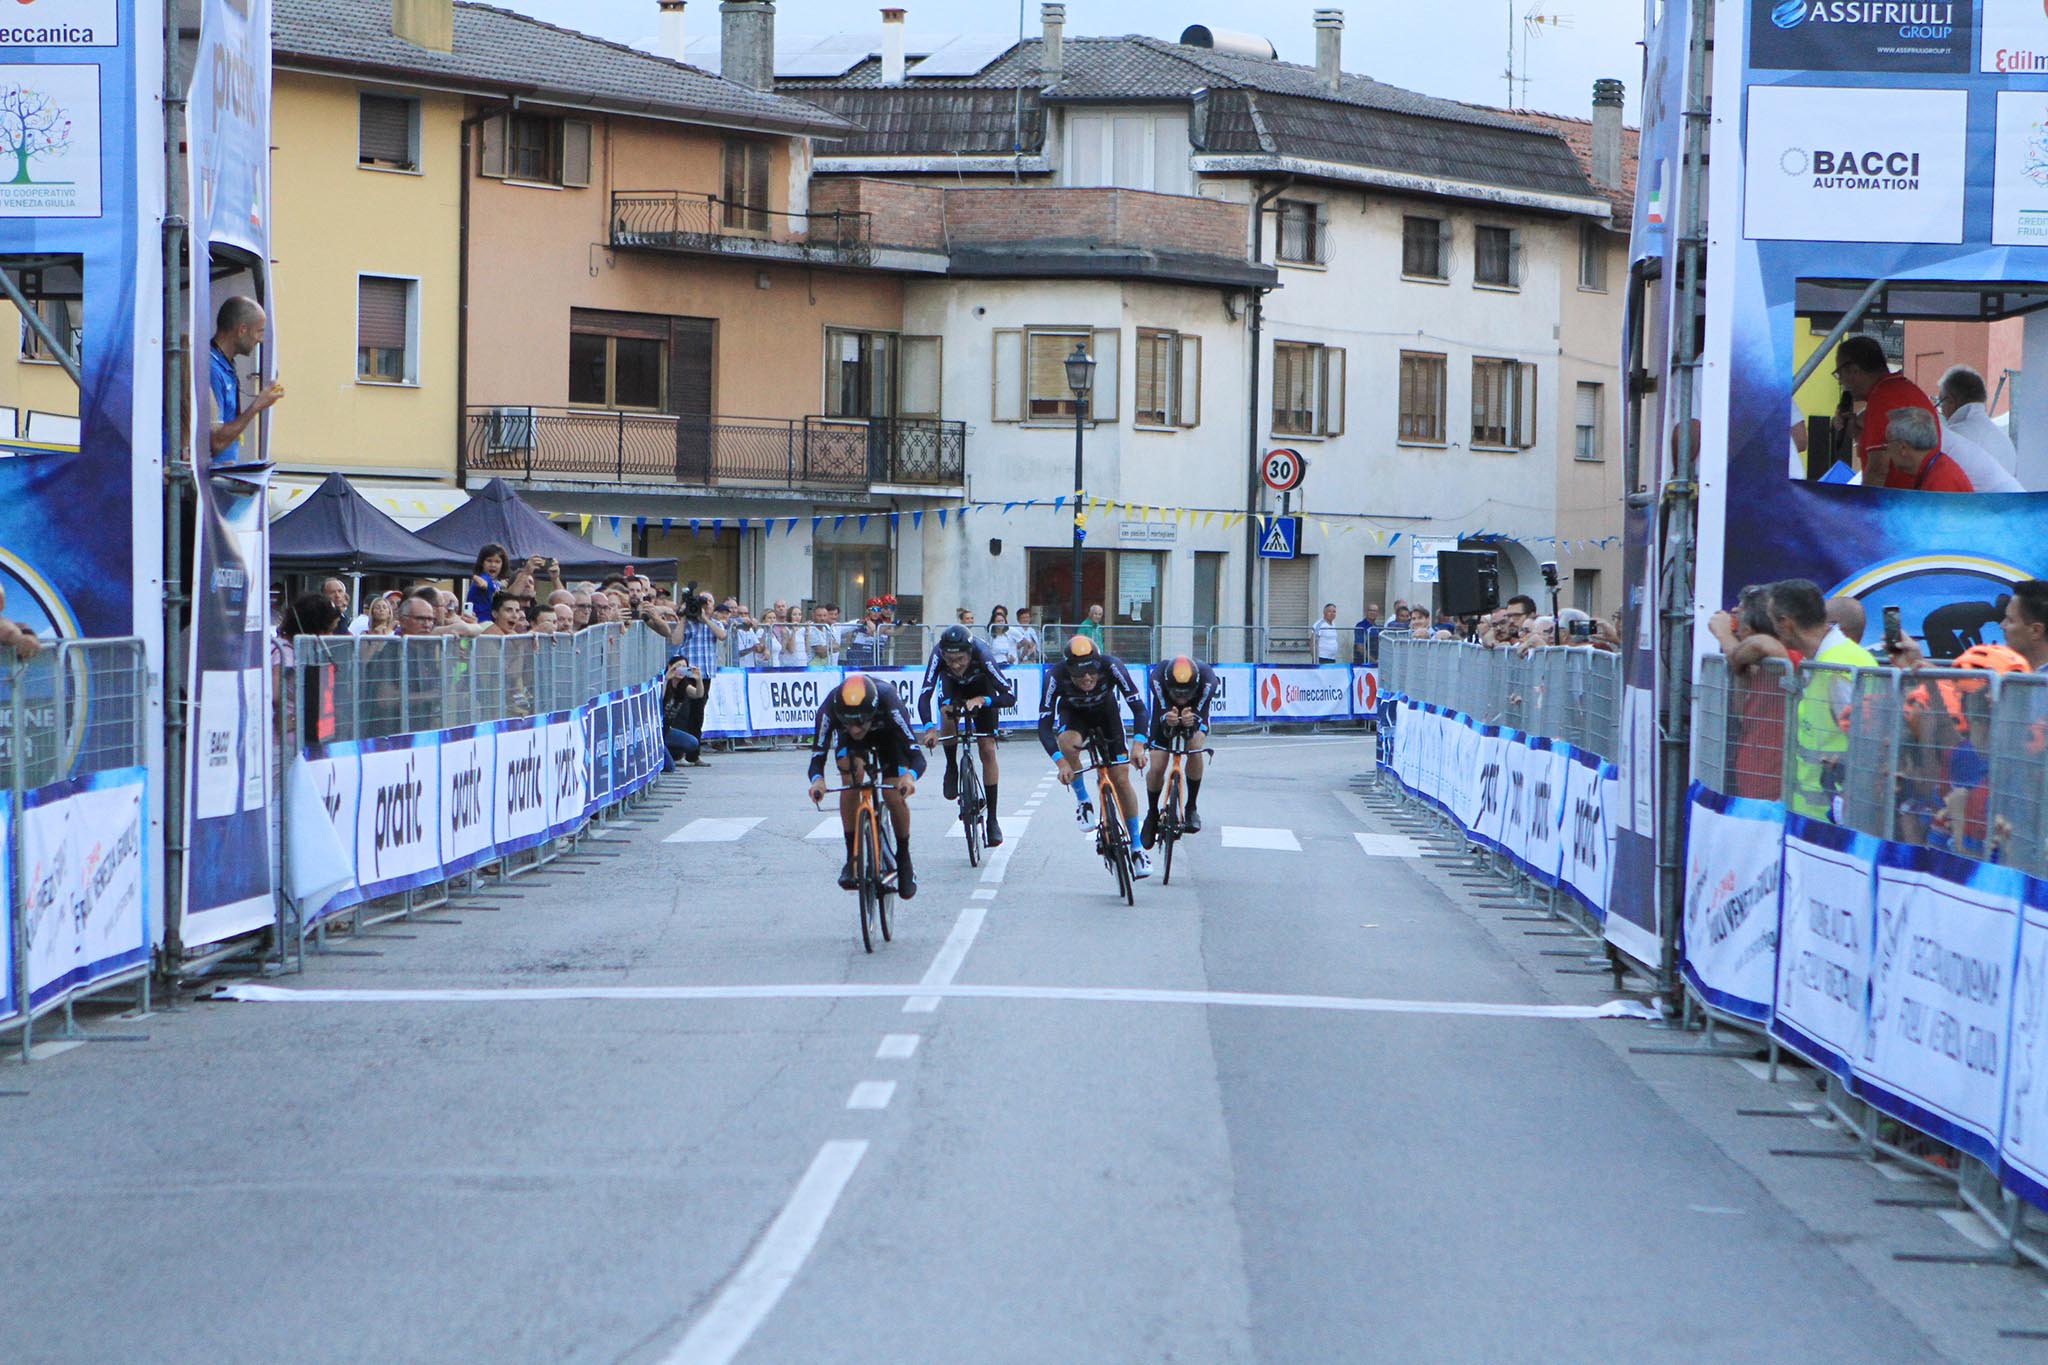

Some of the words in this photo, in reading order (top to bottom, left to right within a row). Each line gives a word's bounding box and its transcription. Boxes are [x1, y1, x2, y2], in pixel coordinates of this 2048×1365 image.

[1809, 1, 1953, 25] ASSIFRIULI
[1898, 26, 1953, 39] GROUP
[1813, 150, 1920, 177] BACCI
[13, 189, 76, 198] COOPERATIVO
[1812, 177, 1920, 191] AUTOMATION
[4, 199, 43, 208] VENEZIA
[44, 199, 76, 208] GIULIA
[1270, 460, 1291, 480] 30
[771, 680, 819, 708] BACCI
[1285, 684, 1343, 704] Edilmeccanica
[507, 730, 542, 838] pratic
[452, 740, 481, 858] pratic
[375, 751, 422, 878] pratic
